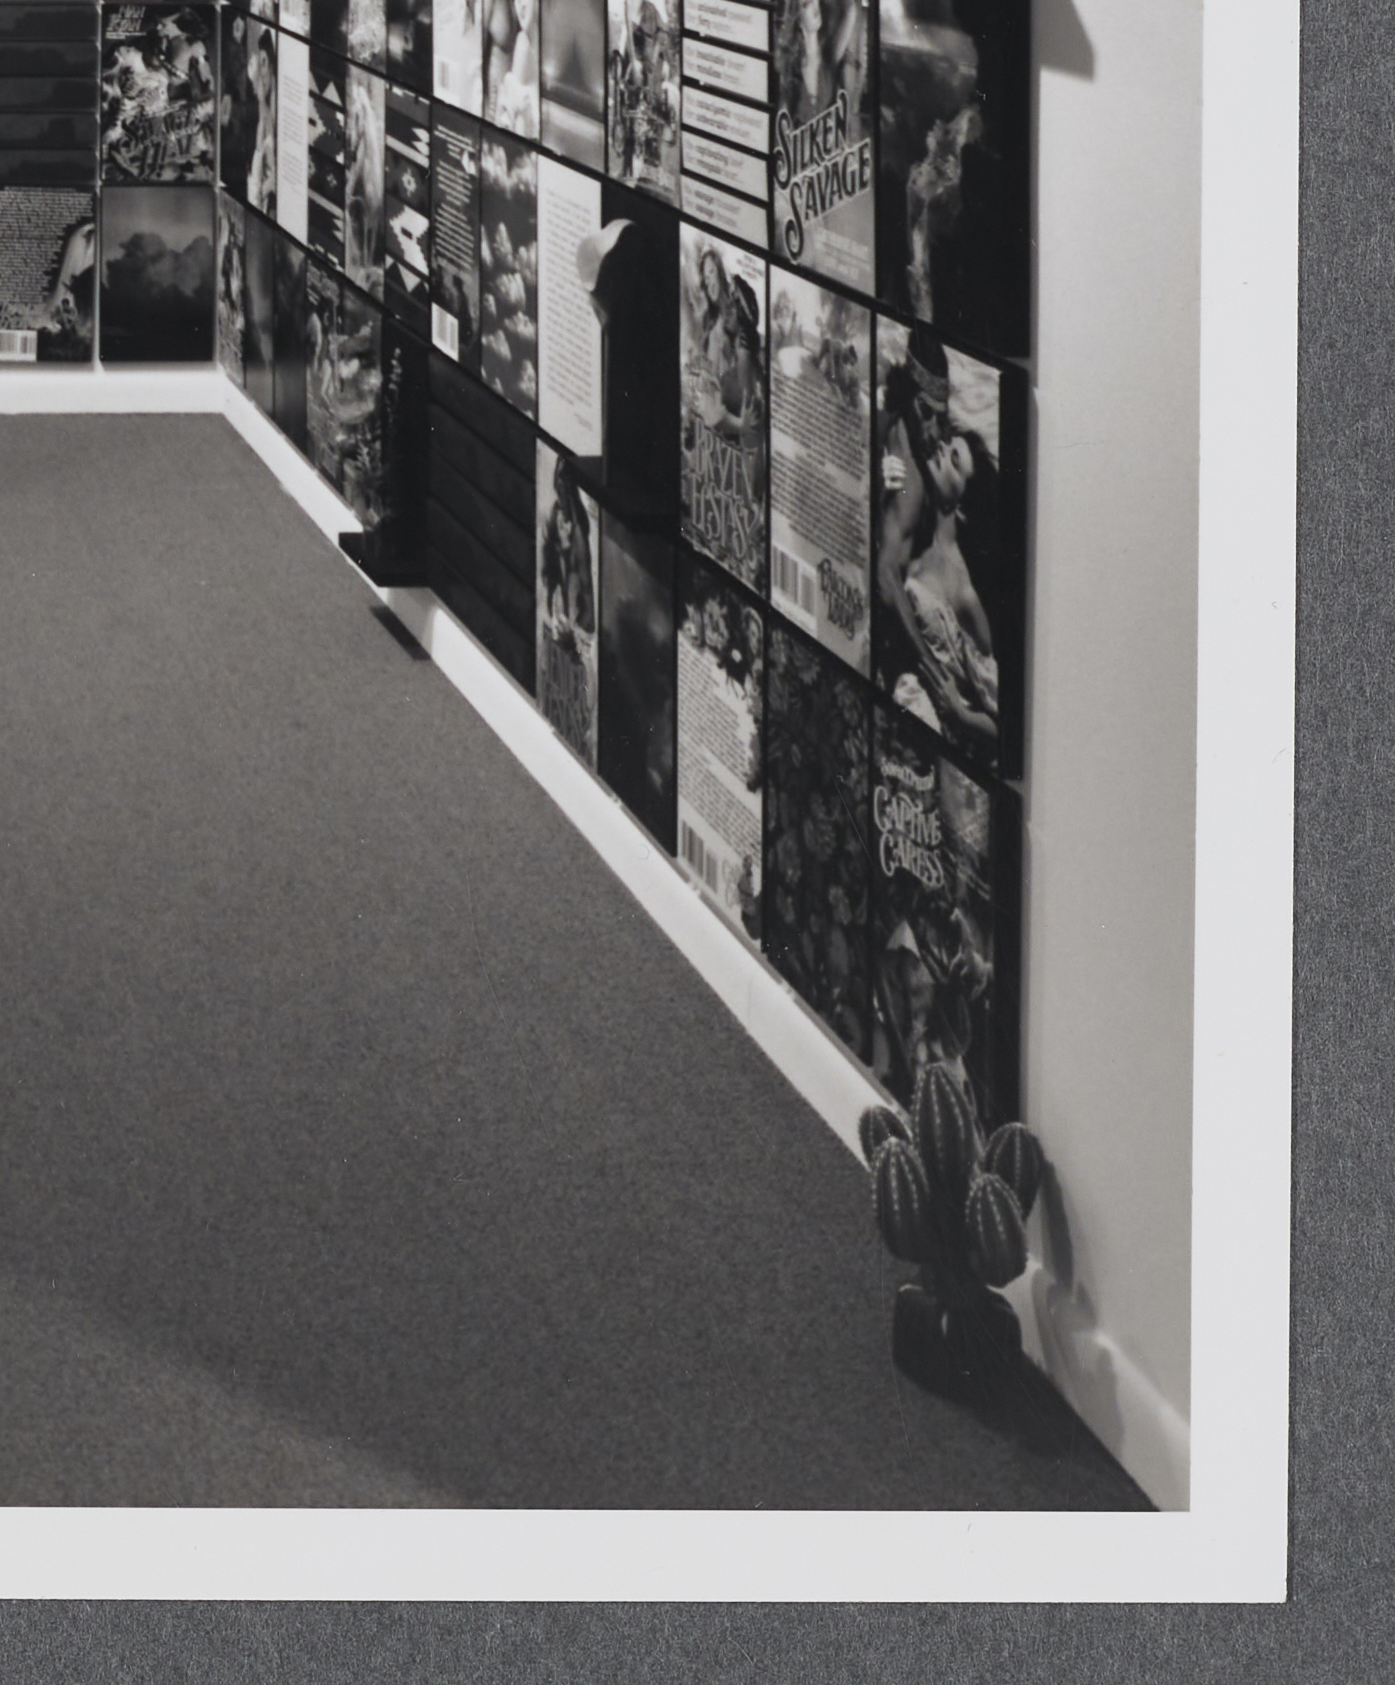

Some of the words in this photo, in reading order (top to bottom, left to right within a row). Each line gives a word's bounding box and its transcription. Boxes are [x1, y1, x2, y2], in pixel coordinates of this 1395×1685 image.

[774, 89, 848, 191] SILKEN
[785, 138, 871, 264] SAVAGE
[873, 785, 943, 847] CAPTIVE
[879, 832, 945, 888] CARESS
